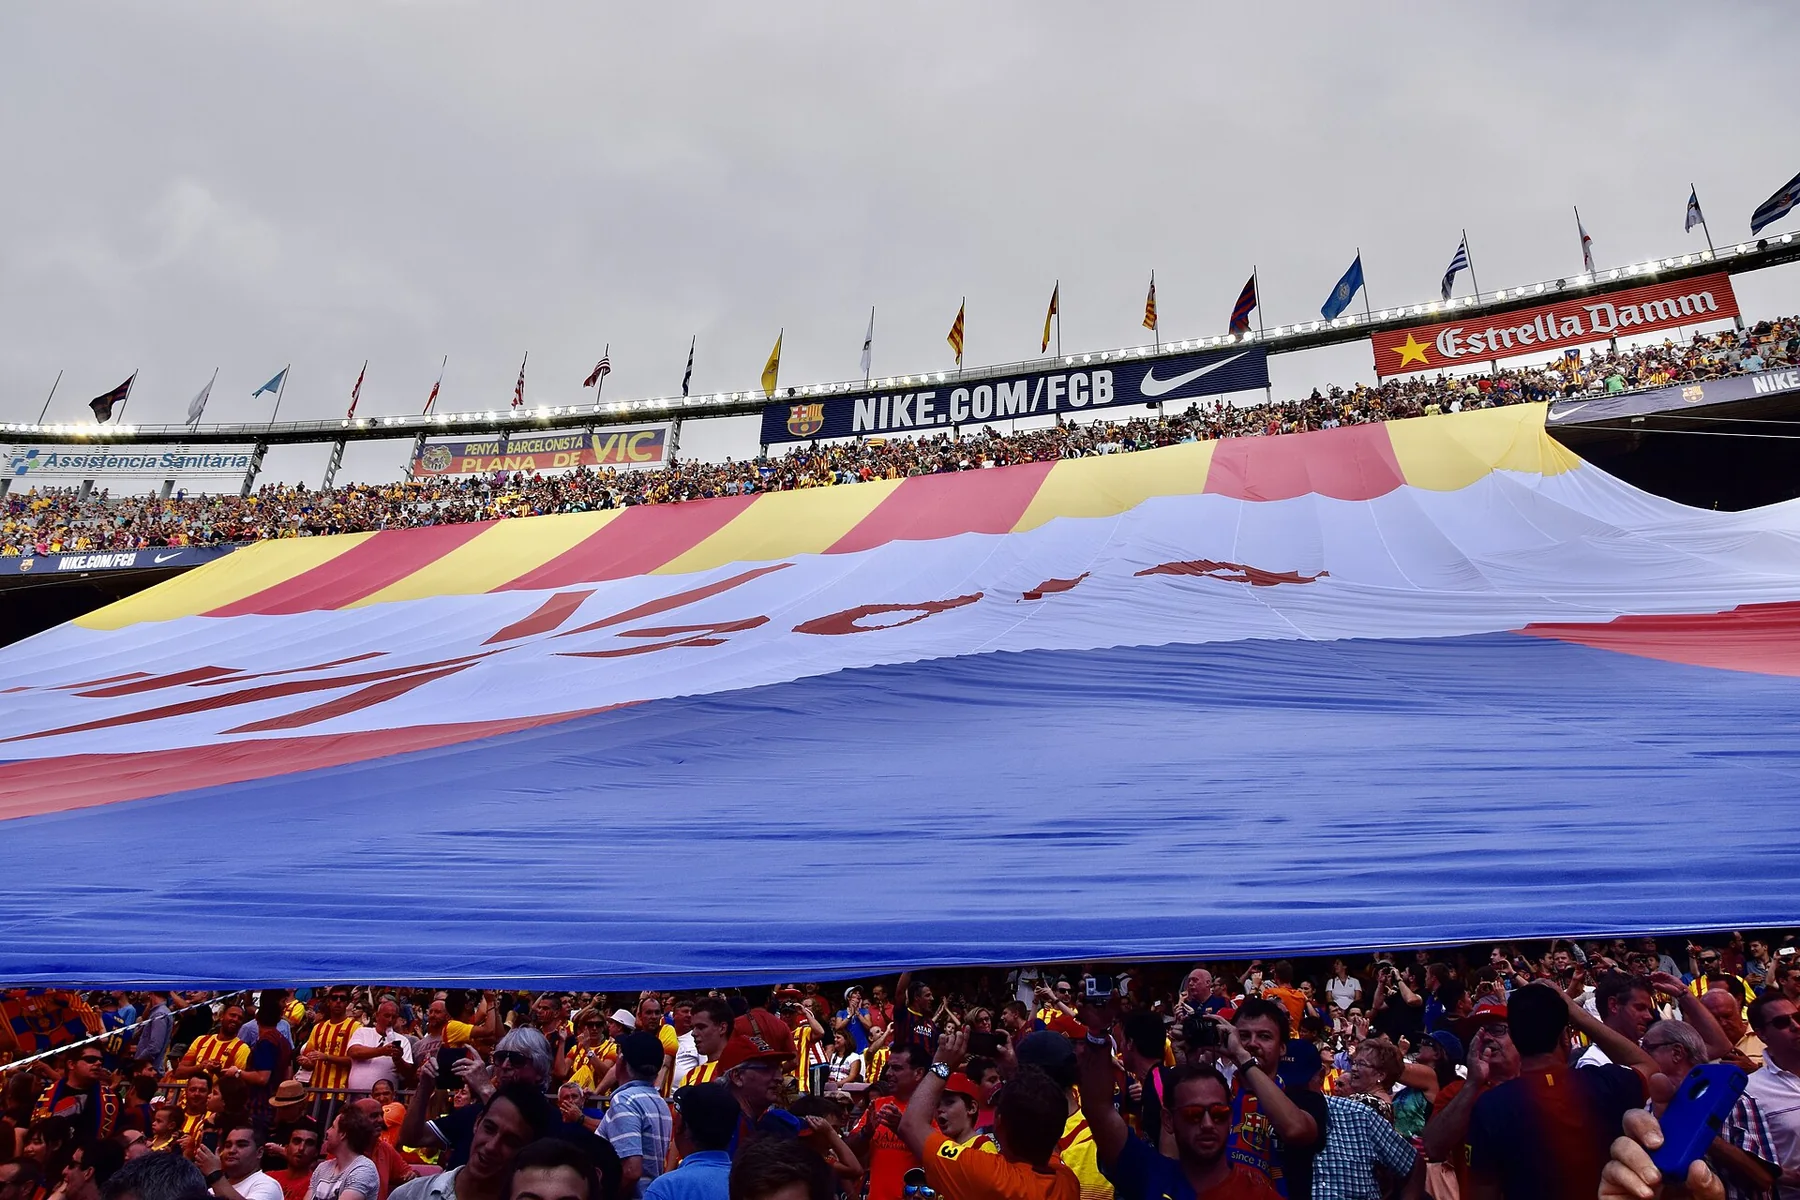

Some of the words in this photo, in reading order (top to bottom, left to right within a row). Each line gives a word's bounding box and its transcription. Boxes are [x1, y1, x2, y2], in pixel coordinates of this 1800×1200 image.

[1436, 312, 1583, 358] Estrella
[1582, 291, 1719, 334] Damm
[852, 370, 1114, 432] NIKE.COM/FCB
[462, 456, 536, 473] PLANA
[553, 452, 581, 467] DE
[591, 431, 655, 463] VIC
[464, 443, 500, 456] PENYA
[506, 436, 583, 453] BARCELONISTA
[43, 452, 157, 468] Assistència
[159, 452, 248, 468] Sanitària
[58, 553, 137, 570] NIKE.COM/FCB
[940, 1145, 958, 1159] 3
[1231, 1151, 1255, 1165] since
